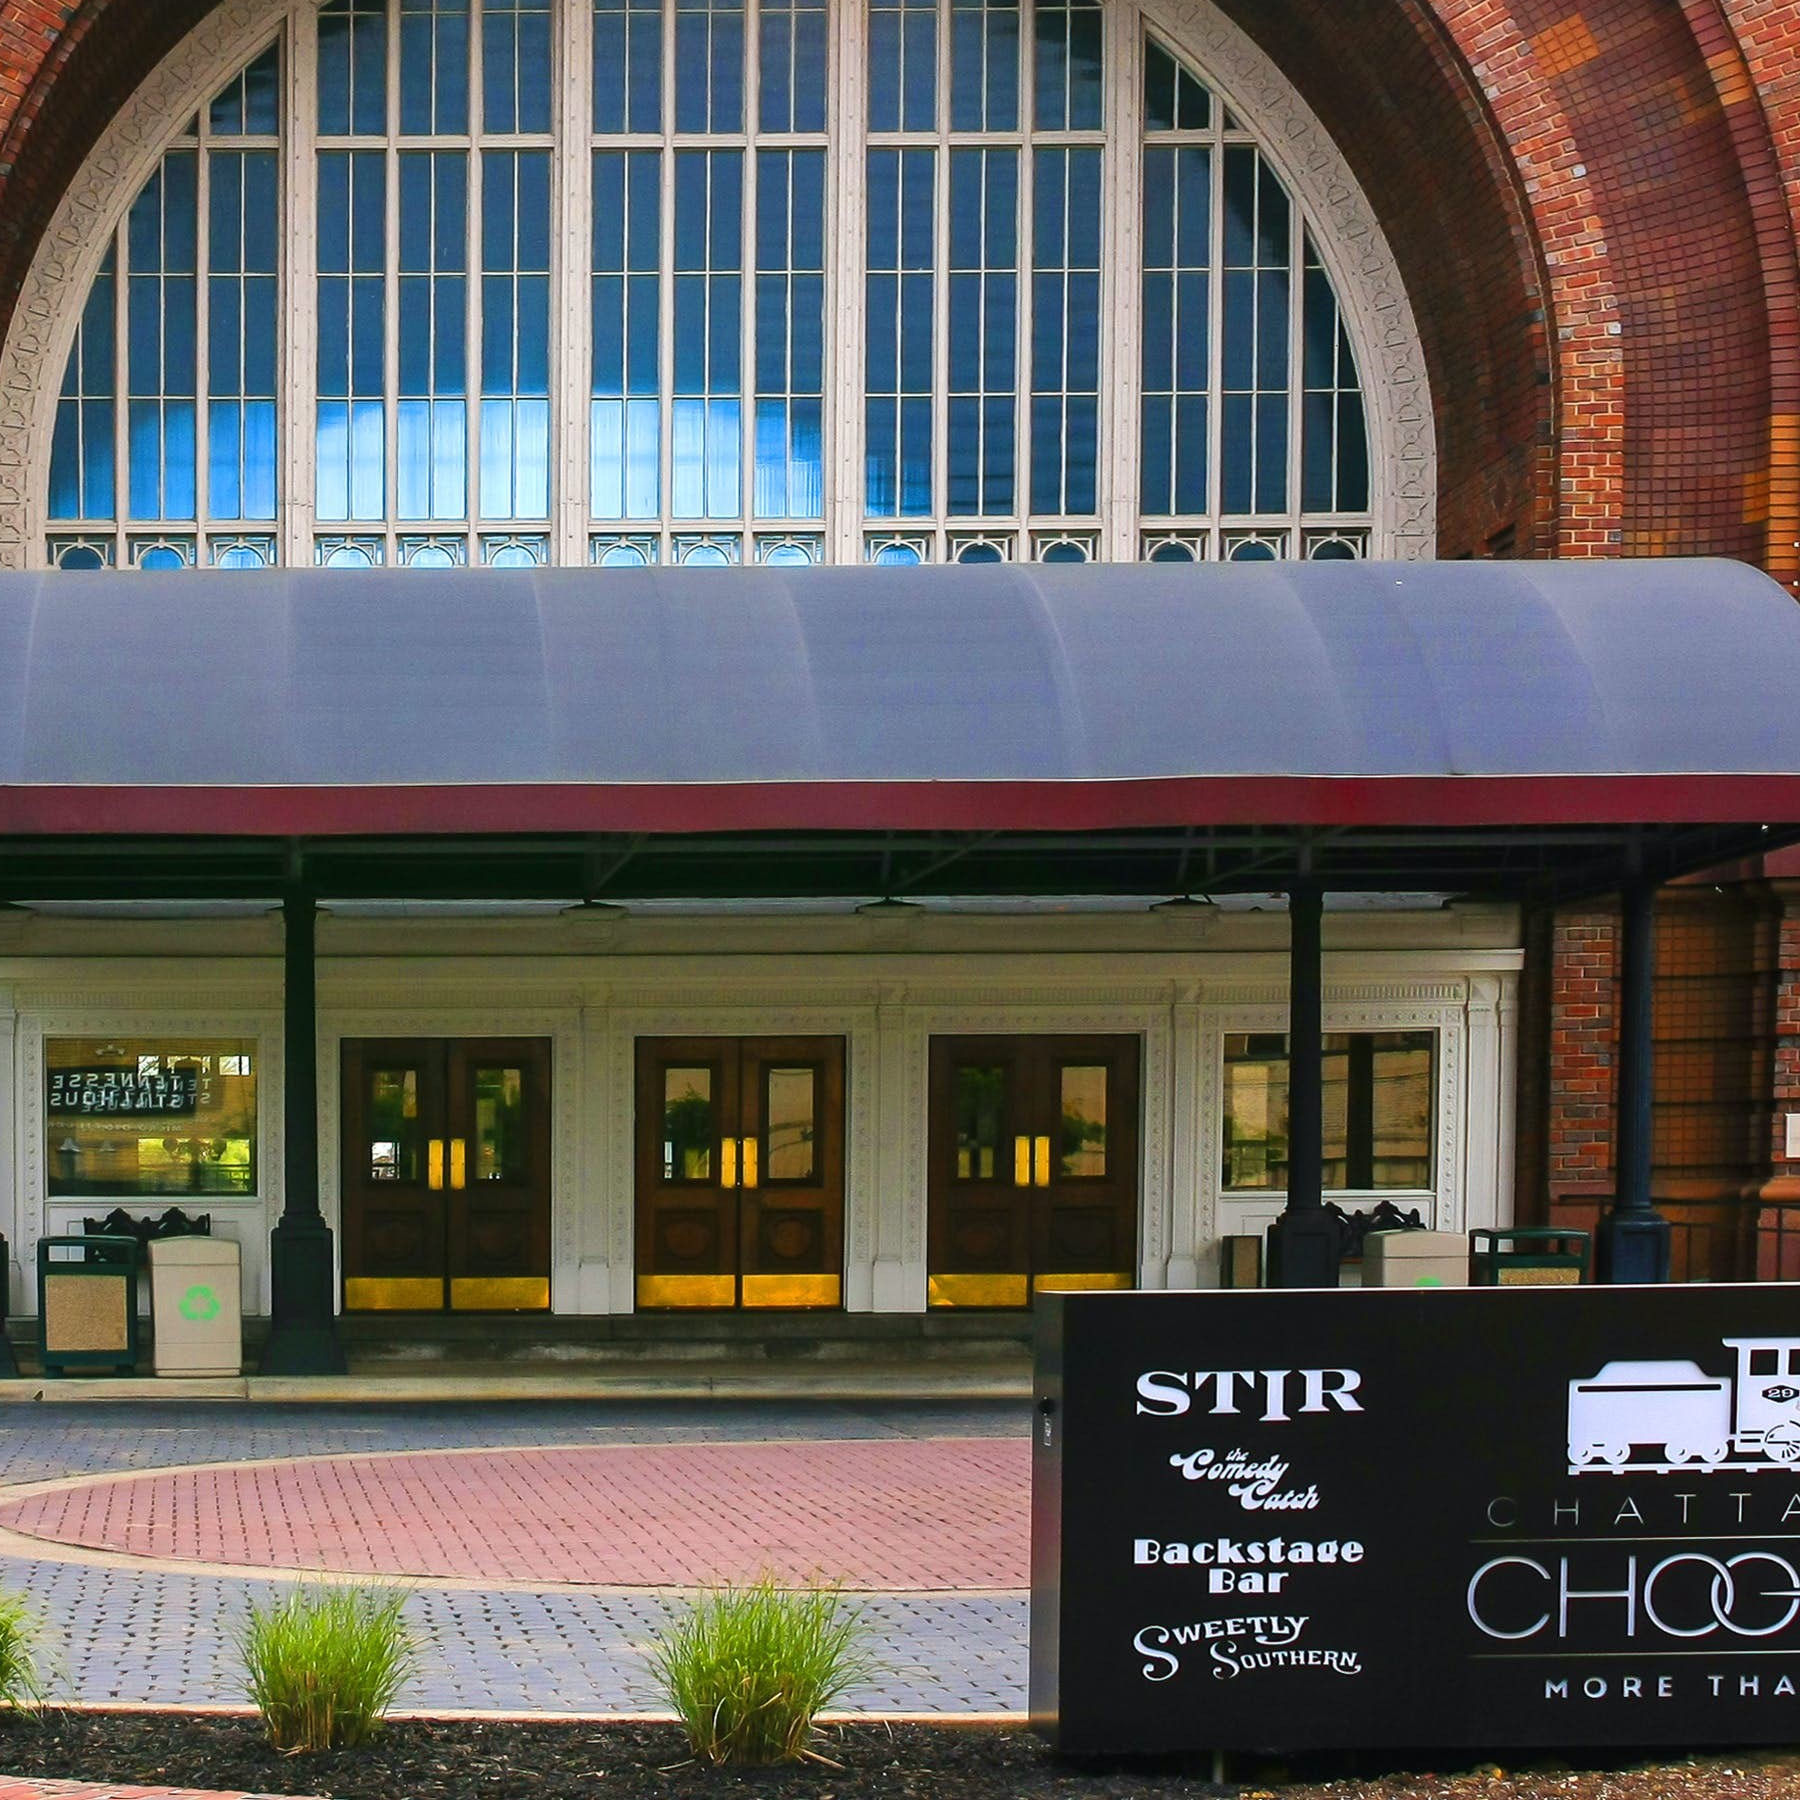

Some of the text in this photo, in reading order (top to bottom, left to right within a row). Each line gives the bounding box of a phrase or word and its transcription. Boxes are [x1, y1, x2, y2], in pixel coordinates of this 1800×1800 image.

[1136, 1368, 1365, 1422] STIR
[1767, 1387, 1794, 1399] 29
[1169, 1448, 1289, 1485] Comedy
[1225, 1448, 1249, 1462] the
[1228, 1480, 1321, 1510] Catch
[1134, 1537, 1365, 1564] Backstage
[1209, 1568, 1289, 1594] Bar
[1545, 1675, 1673, 1699] MORE
